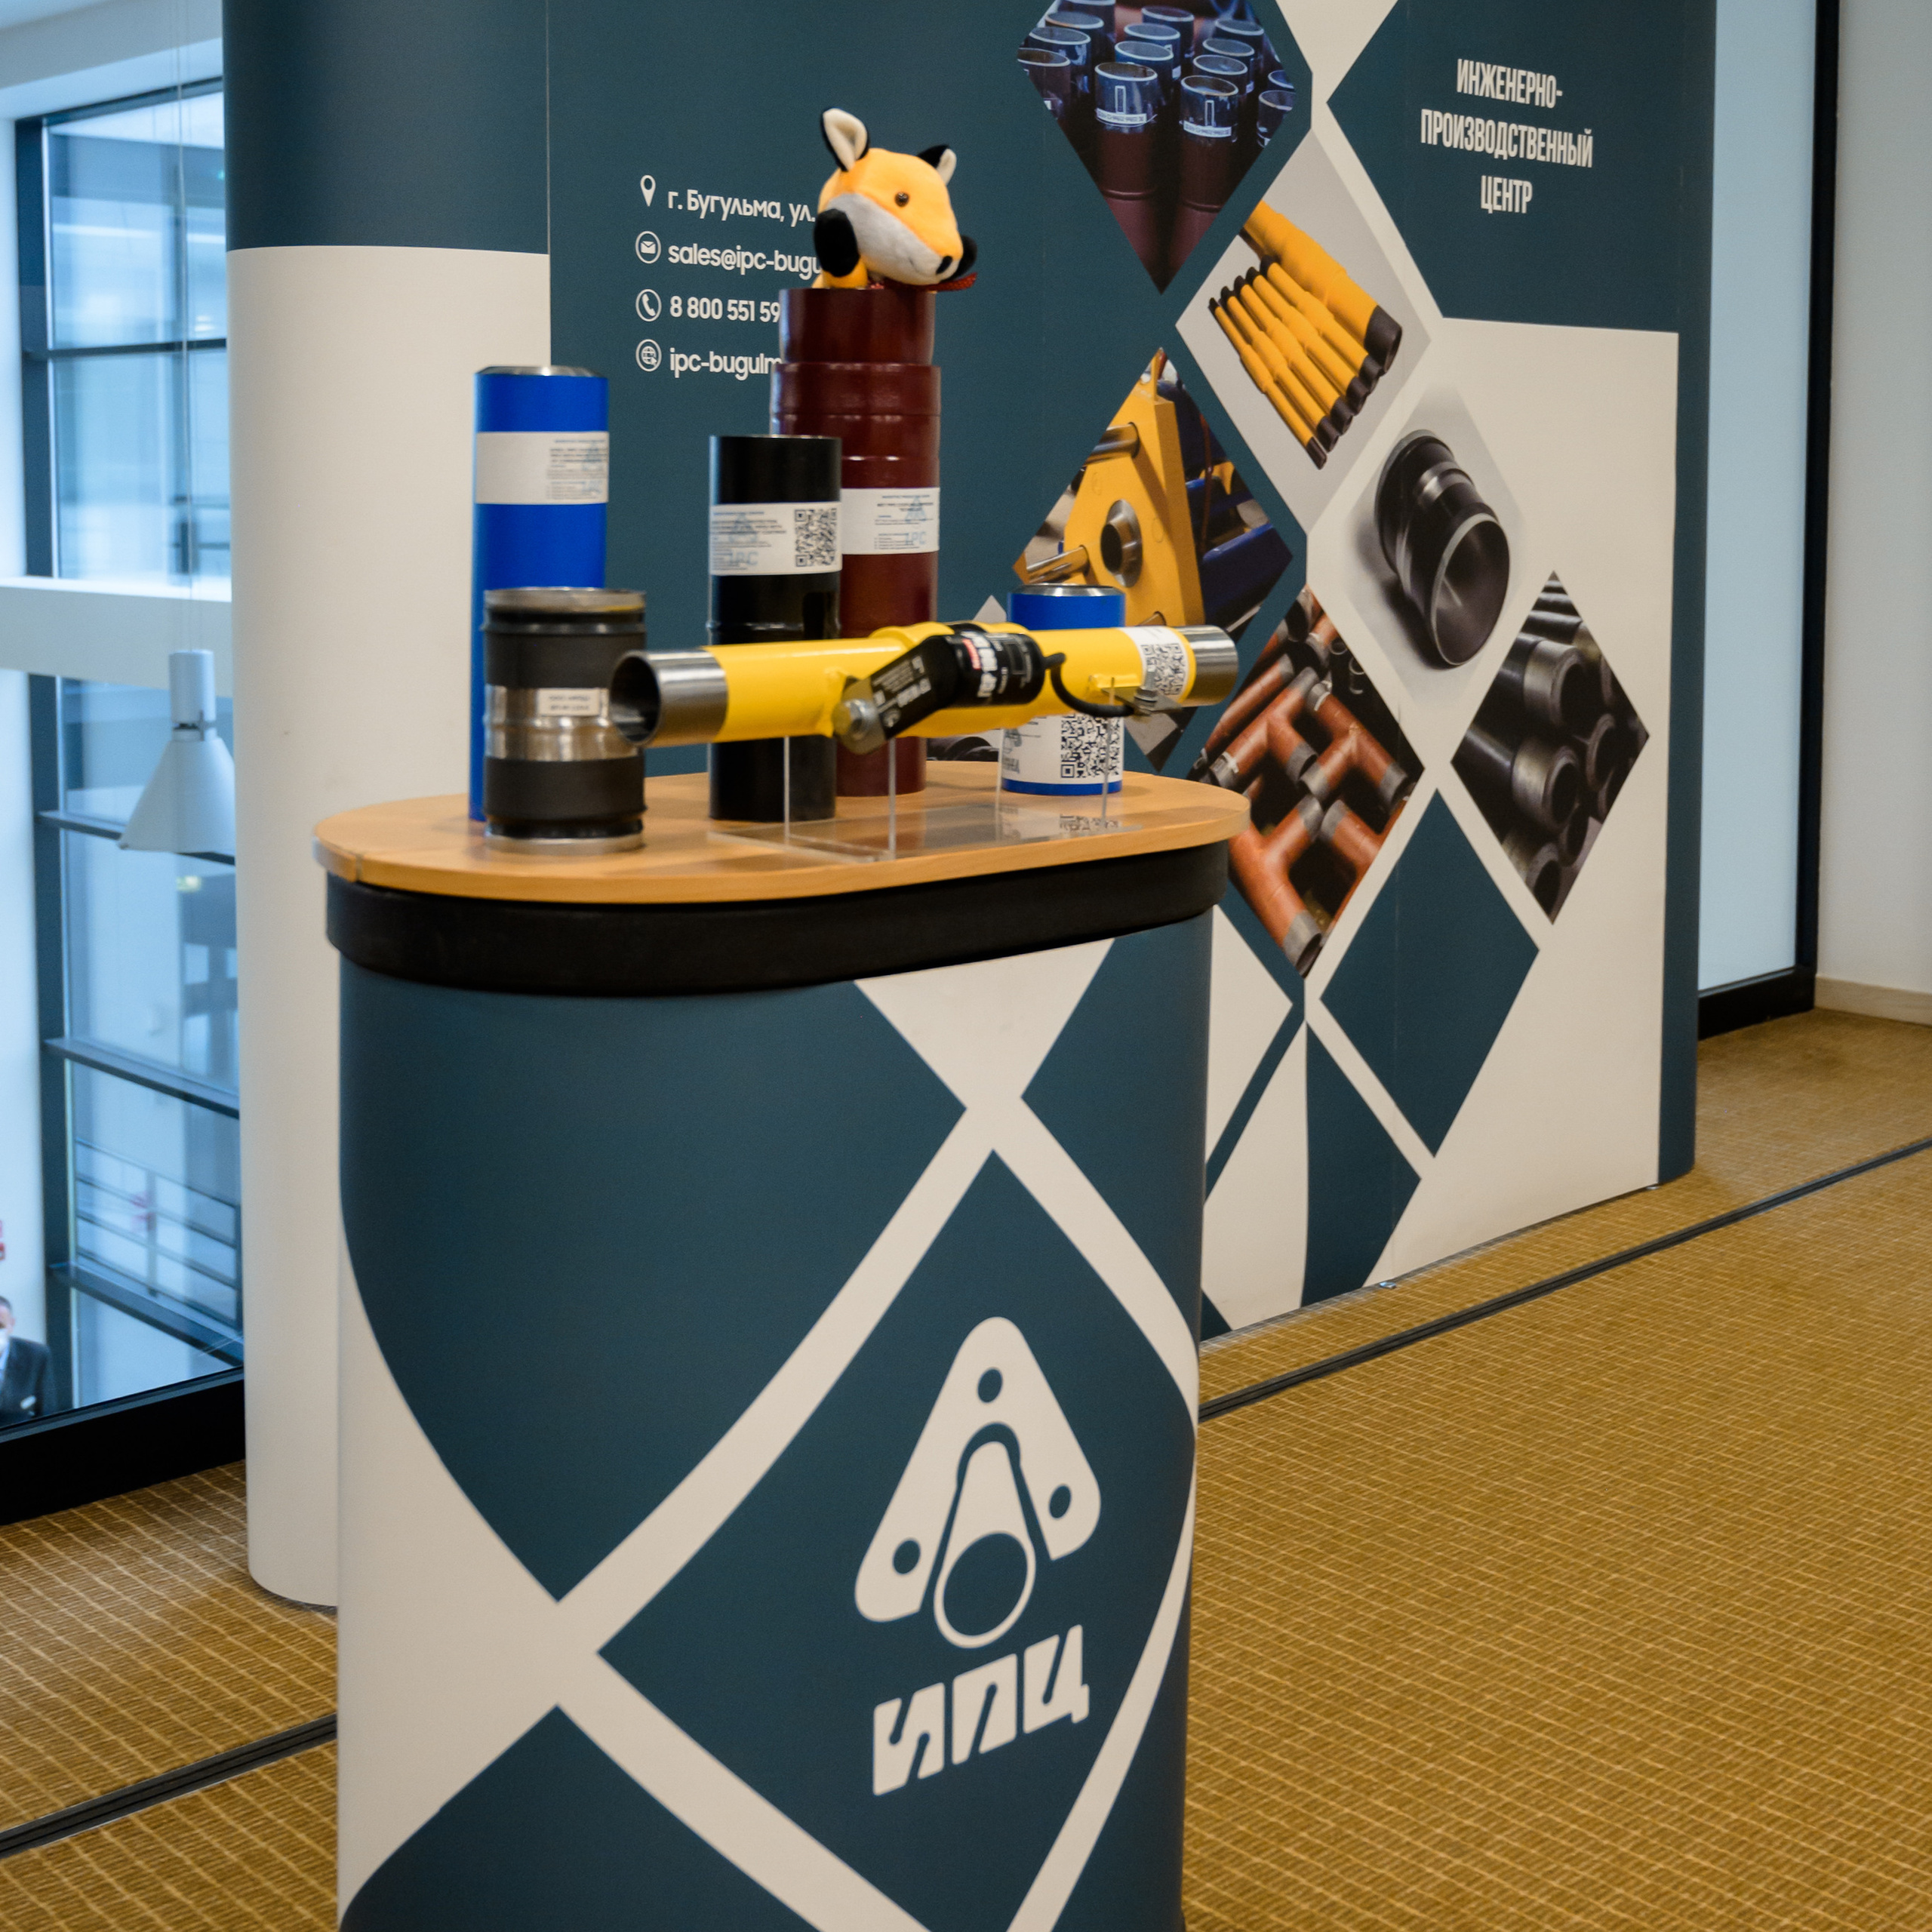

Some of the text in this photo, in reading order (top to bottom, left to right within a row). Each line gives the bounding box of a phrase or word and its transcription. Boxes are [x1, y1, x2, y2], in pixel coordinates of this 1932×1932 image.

[1457, 58, 1563, 109] ИНЖЕНЕРНО-
[1420, 109, 1594, 168] ПРОИЗВОДСТВЕННЫЙ
[668, 189, 816, 228] г. Бугульма, ул.
[1480, 175, 1533, 214] ЦЕНТР
[670, 296, 780, 323] 8 800 551 59
[872, 1624, 1090, 1796] ИПЦ
